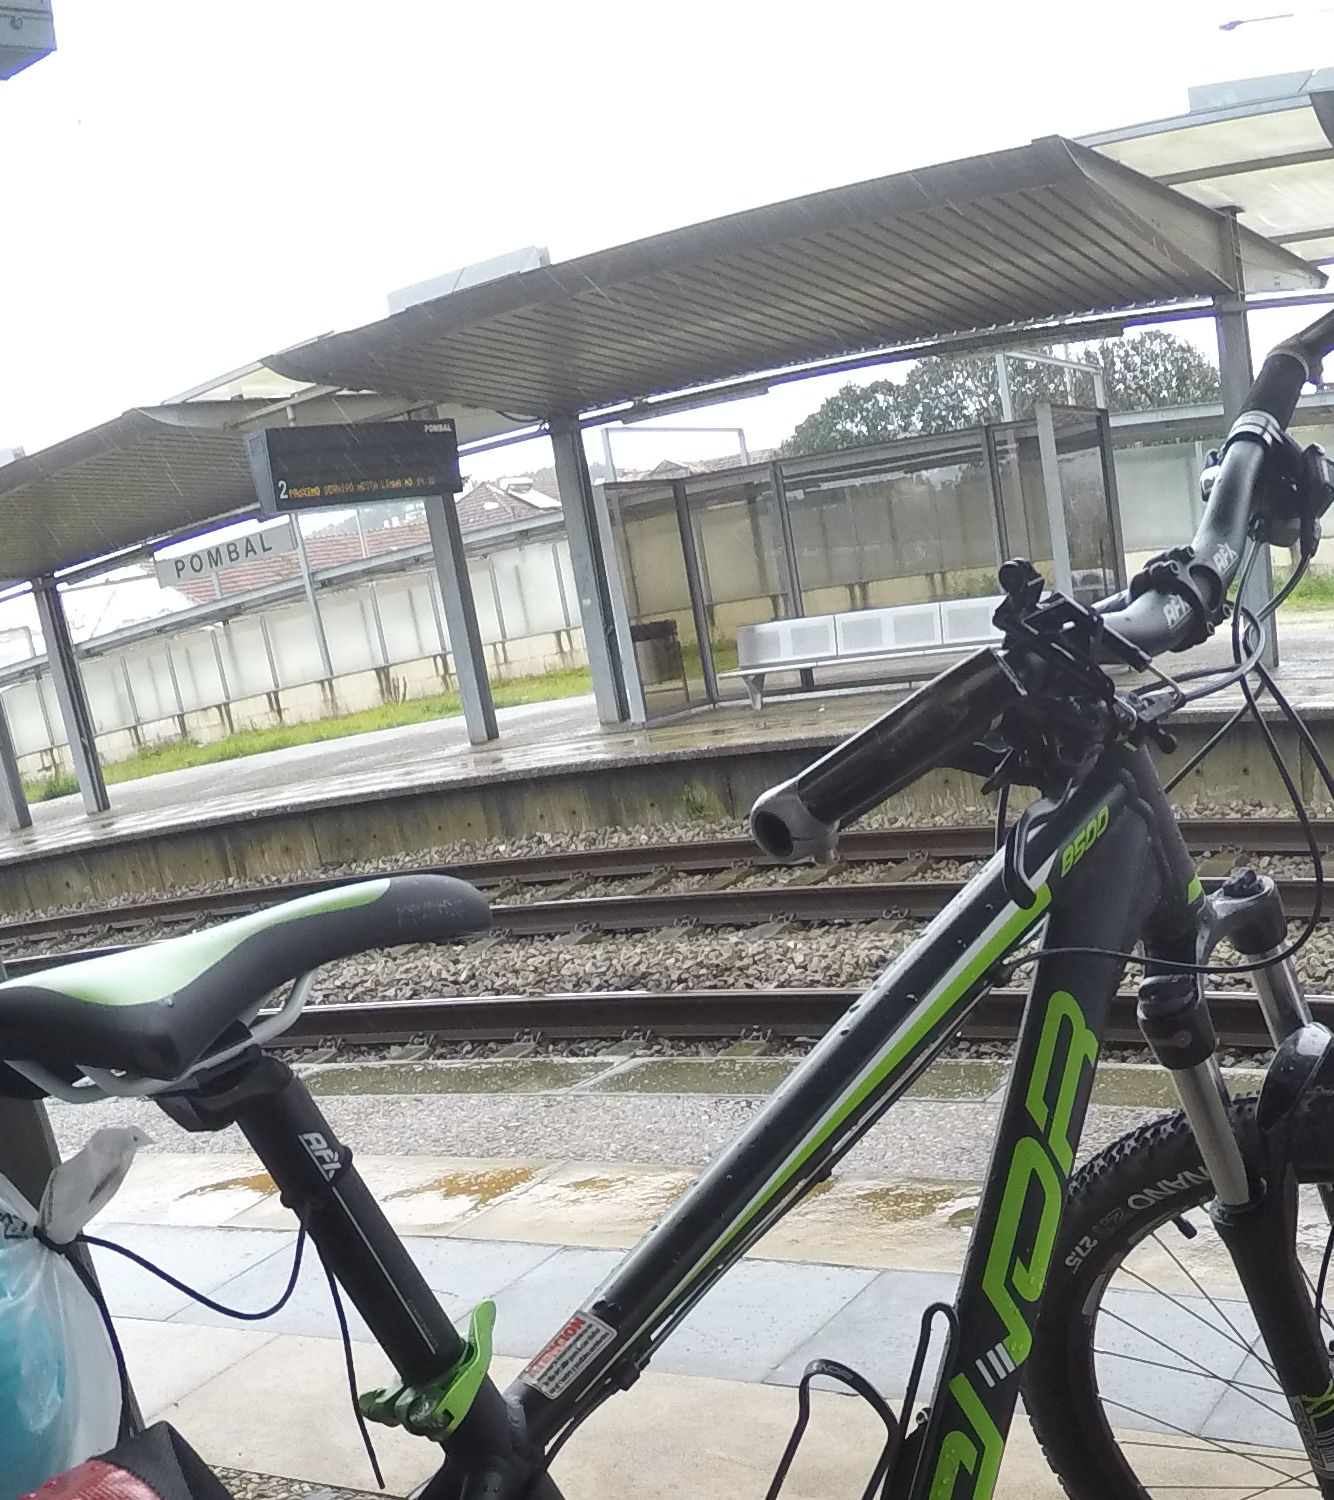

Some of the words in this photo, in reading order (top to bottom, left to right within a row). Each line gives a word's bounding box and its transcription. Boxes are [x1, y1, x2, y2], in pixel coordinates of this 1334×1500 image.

[278, 480, 289, 500] 2
[174, 533, 273, 579] POMBAL
[1060, 804, 1110, 878] 8500
